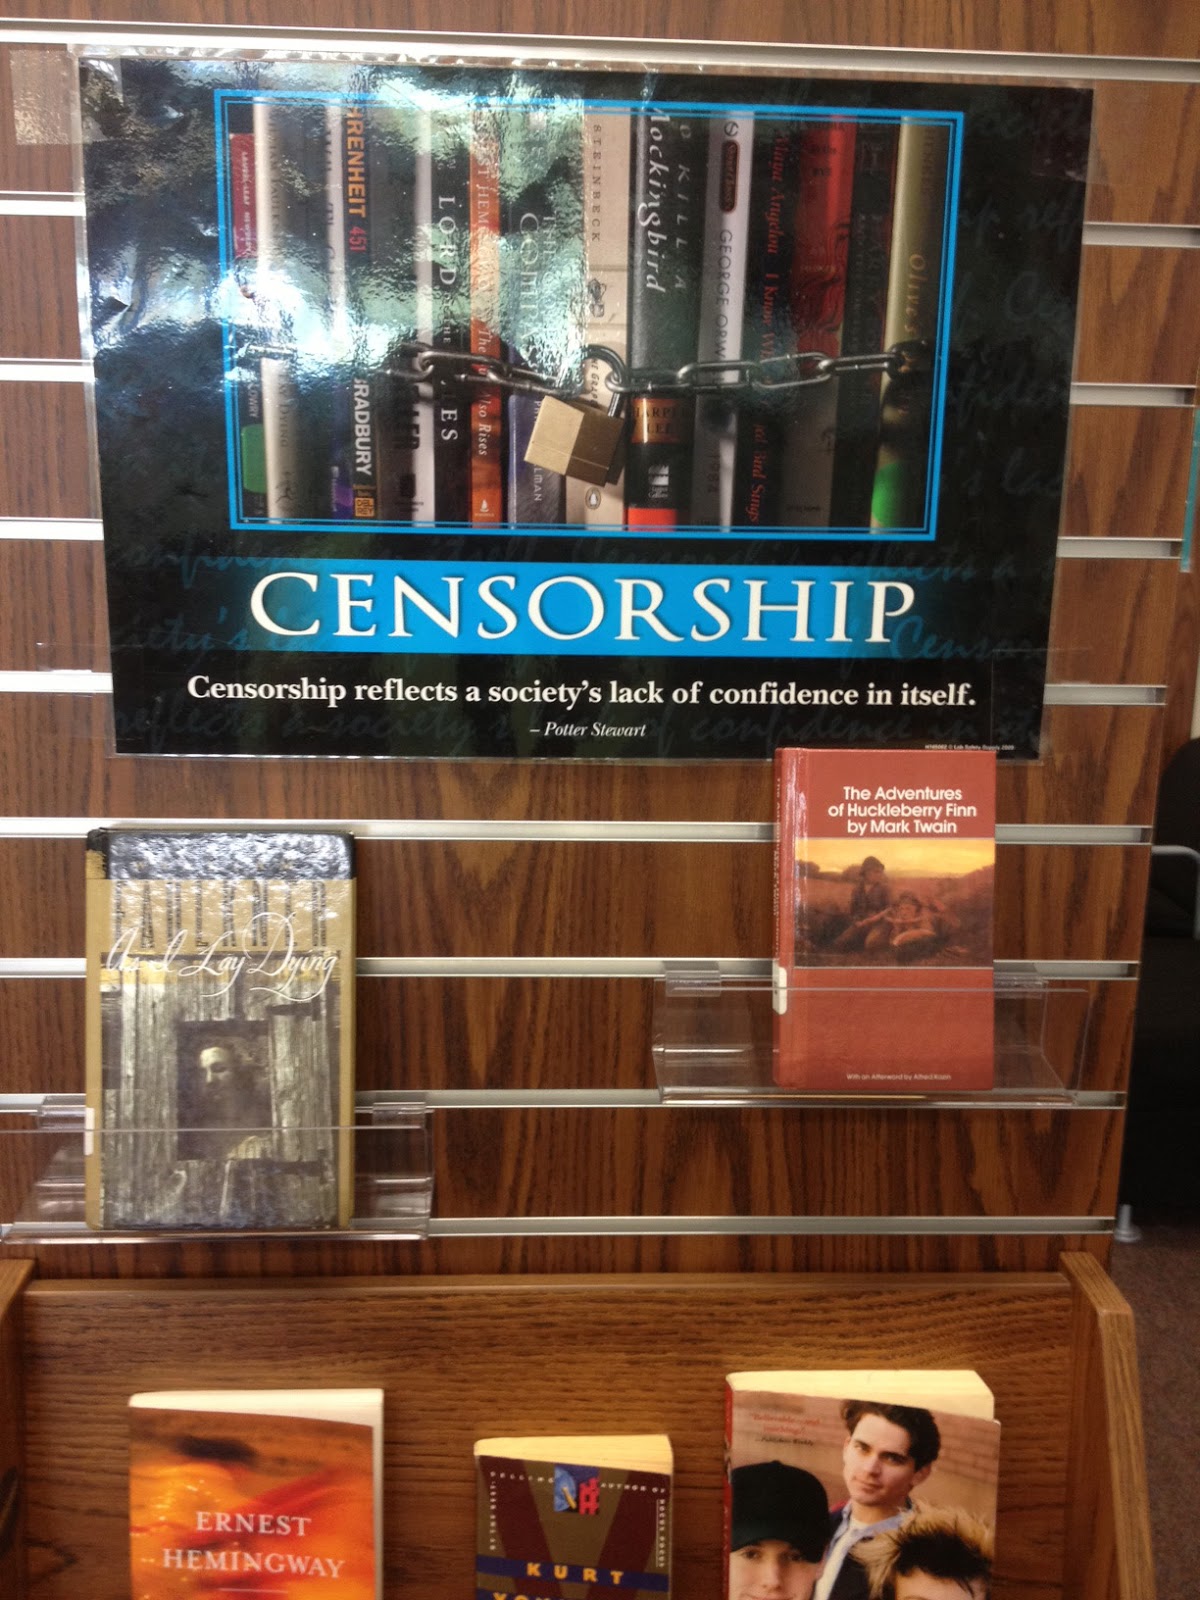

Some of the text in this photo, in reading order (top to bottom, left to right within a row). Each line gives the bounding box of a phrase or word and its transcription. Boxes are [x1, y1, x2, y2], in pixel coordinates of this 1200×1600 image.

[591, 124, 602, 243] STEINBECK
[764, 186, 786, 254] Angelou
[349, 226, 367, 253] 451
[438, 195, 457, 285] LORD
[716, 229, 733, 306] GEORGE
[477, 423, 491, 456] Rises
[250, 571, 916, 643] CENSORSHIP
[187, 674, 977, 711] Censorship reflects a society's lack of confidence in itself.
[544, 721, 589, 738] Potter
[590, 721, 647, 738] Stewart
[843, 786, 962, 801] The Adventures
[828, 802, 978, 820] of Huckleberry Finn
[847, 819, 958, 837] by Mark Twain
[178, 930, 247, 998] Lay
[241, 912, 339, 1002] Dying
[904, 1074, 912, 1082] by
[195, 1510, 312, 1537] ERNEST
[161, 1547, 347, 1580] HEMINGWAY
[526, 1561, 625, 1586] KURT
